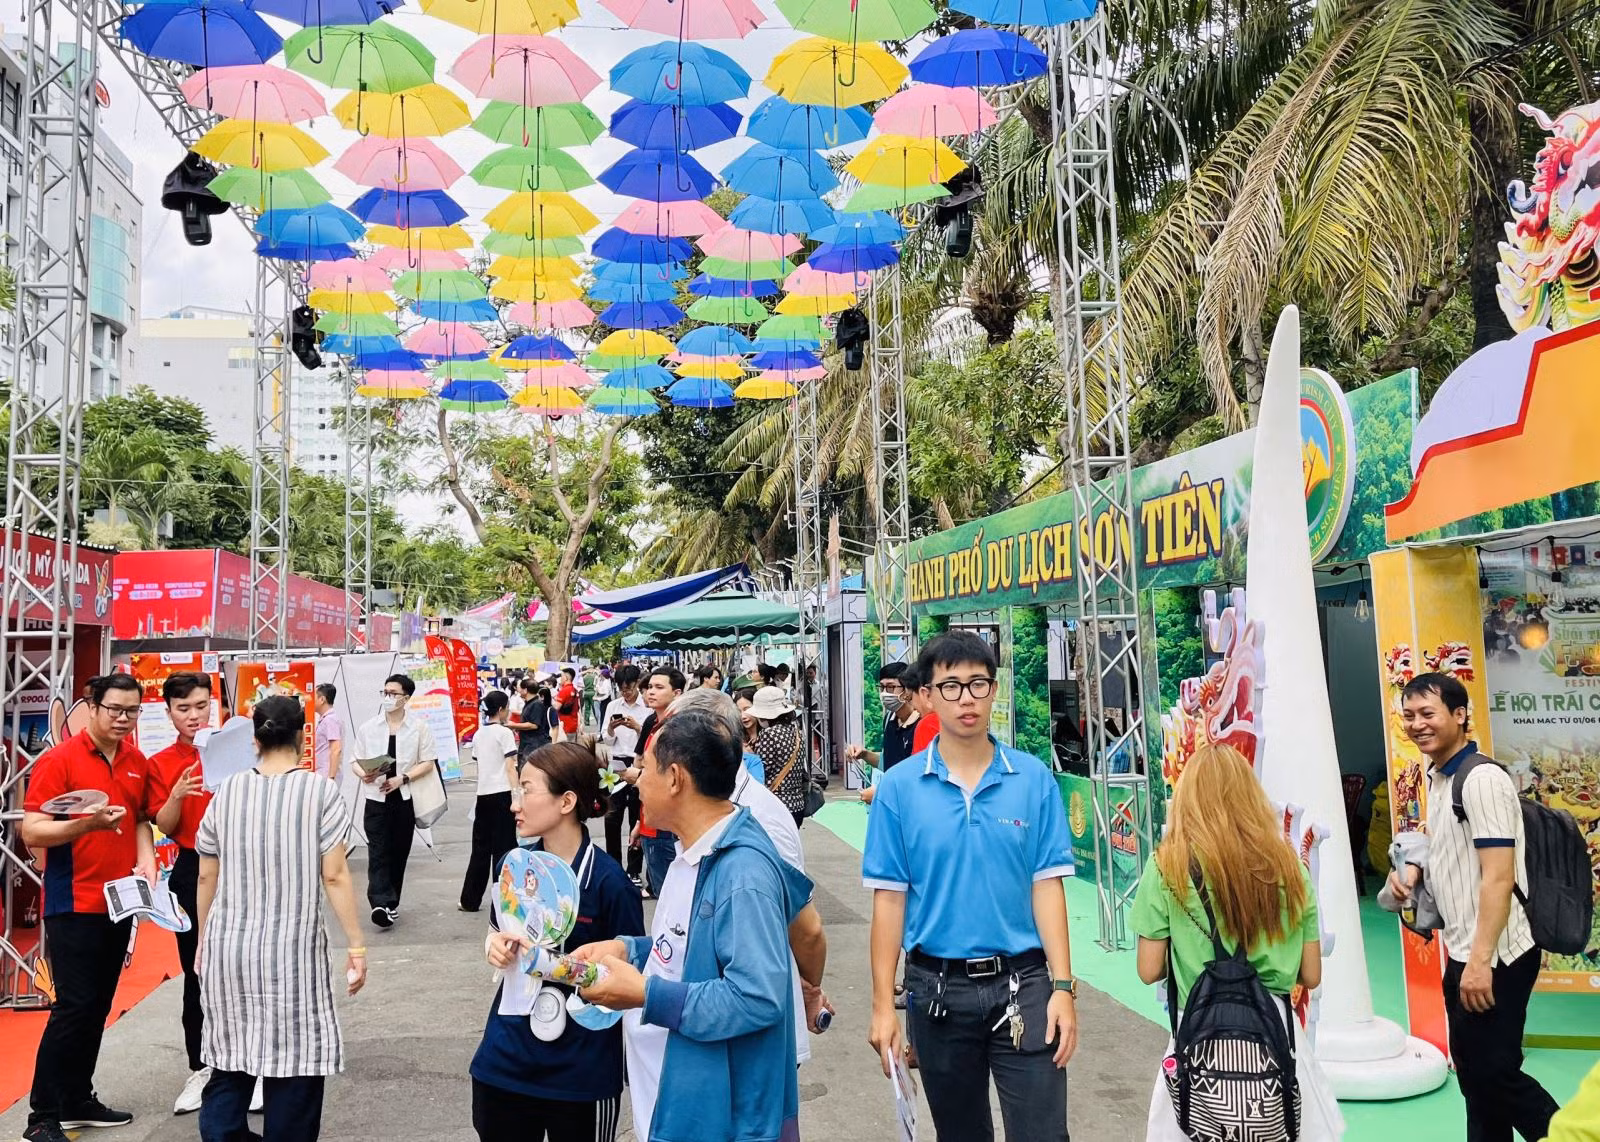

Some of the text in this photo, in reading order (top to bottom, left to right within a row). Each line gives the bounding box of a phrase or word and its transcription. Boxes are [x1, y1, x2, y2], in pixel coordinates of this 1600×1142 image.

[910, 548, 945, 602] HÀNH
[948, 525, 984, 599] PHỐ
[986, 536, 1014, 592] DU
[1018, 520, 1073, 598] LỊCH
[1141, 470, 1224, 567] TIÊN
[1511, 692, 1537, 716] HỘI
[1542, 690, 1584, 712] TRÁI
[1513, 717, 1535, 725] KHAI
[1572, 716, 1596, 725] 01/06
